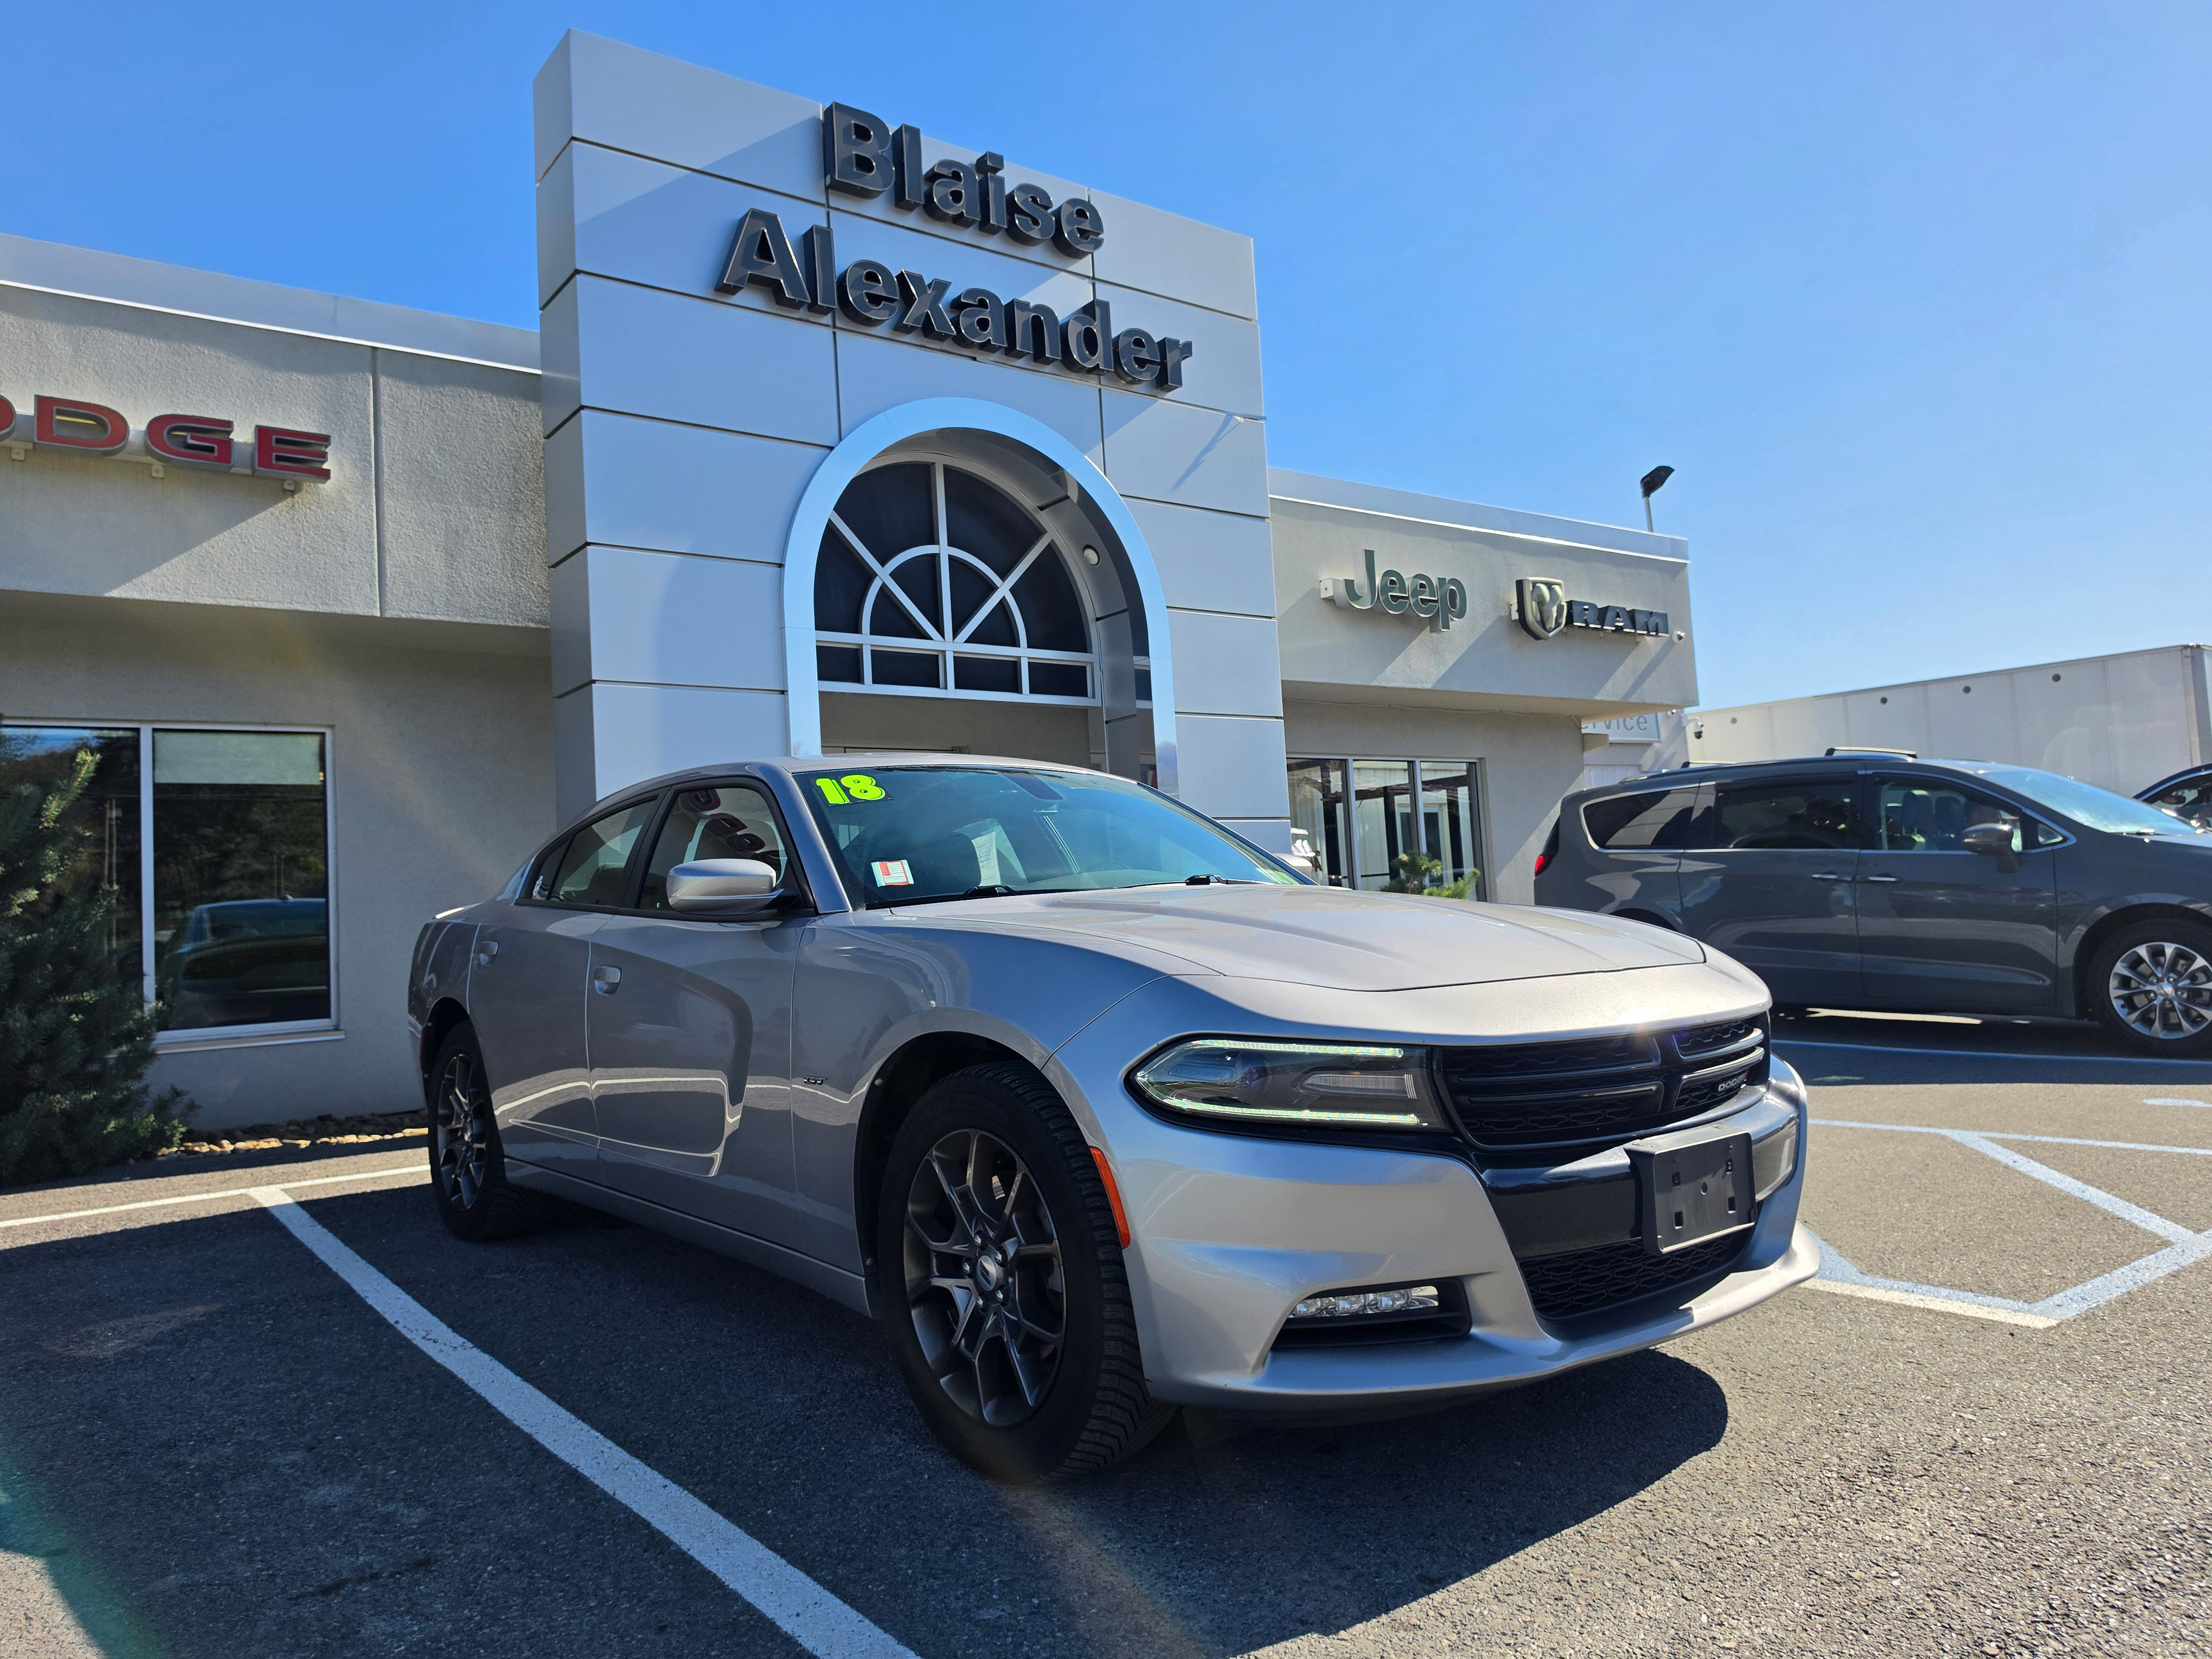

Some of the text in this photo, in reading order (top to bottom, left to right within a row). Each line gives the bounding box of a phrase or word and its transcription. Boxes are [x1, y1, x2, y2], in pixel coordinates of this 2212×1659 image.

[824, 101, 1104, 259] Blaise
[715, 208, 1192, 392] Alexander
[0, 394, 331, 483] DGE
[1343, 549, 1467, 632] Jeep
[1569, 600, 1670, 637] RAM
[816, 774, 886, 805] 18
